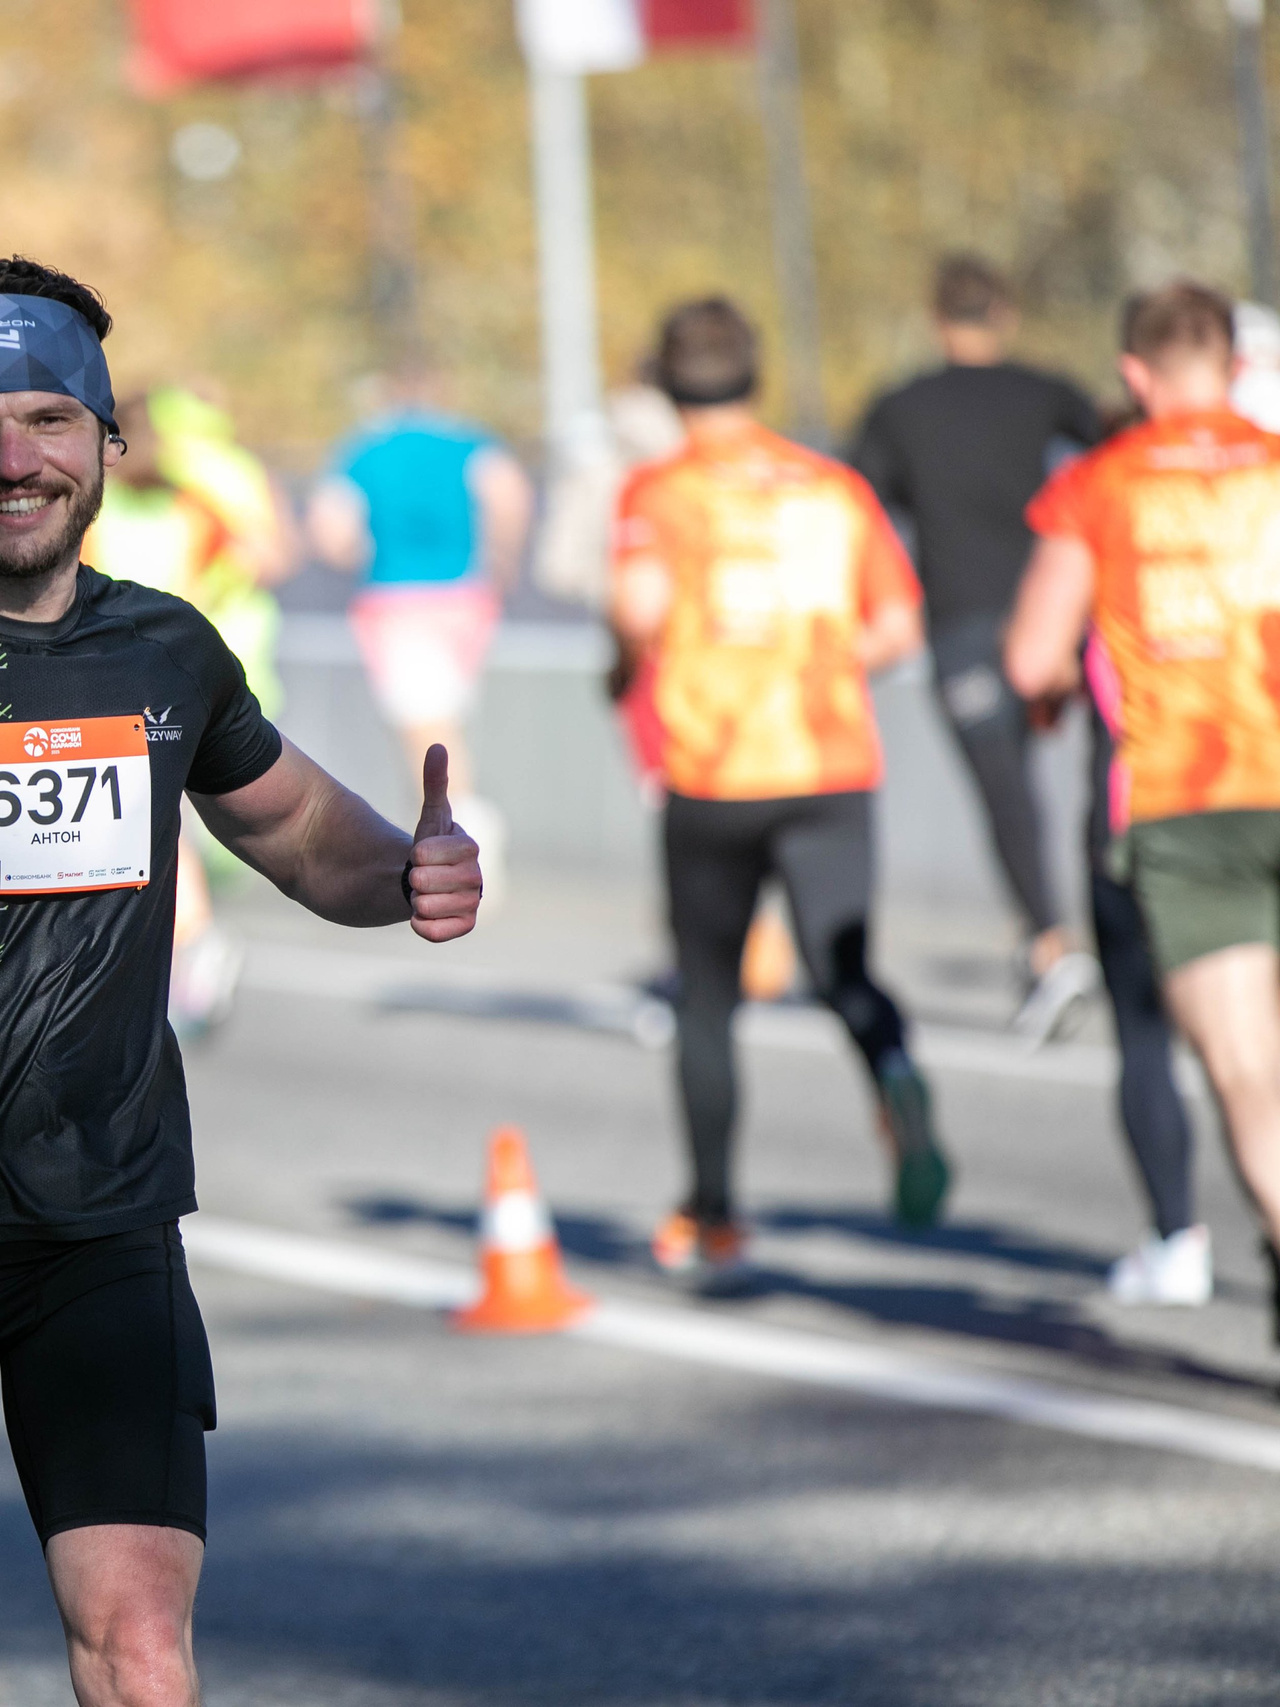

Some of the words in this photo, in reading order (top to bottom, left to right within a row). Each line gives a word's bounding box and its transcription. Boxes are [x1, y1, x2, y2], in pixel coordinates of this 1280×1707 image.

[50, 732, 82, 743] СОЧИ
[145, 730, 183, 741] AZYWAY
[30, 831, 81, 845] АНТОН
[11, 873, 52, 881] СОВКОМБАНК
